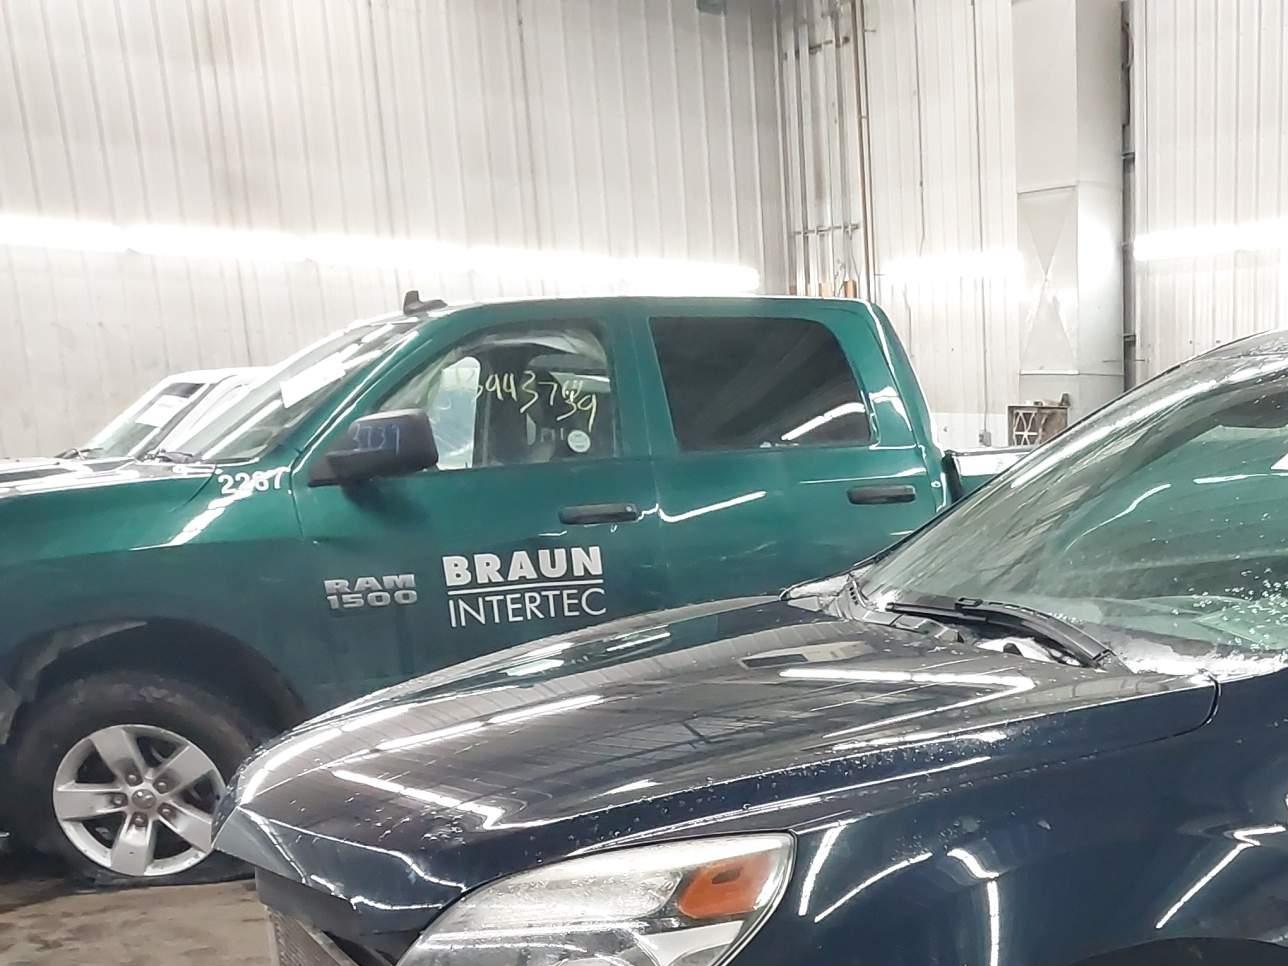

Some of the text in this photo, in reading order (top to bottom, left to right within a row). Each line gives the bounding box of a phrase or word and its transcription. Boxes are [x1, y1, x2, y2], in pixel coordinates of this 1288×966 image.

[442, 546, 603, 586] BRAUN
[324, 574, 416, 593] RAM
[327, 590, 418, 610] 1500
[449, 588, 607, 628] INTERTEC
